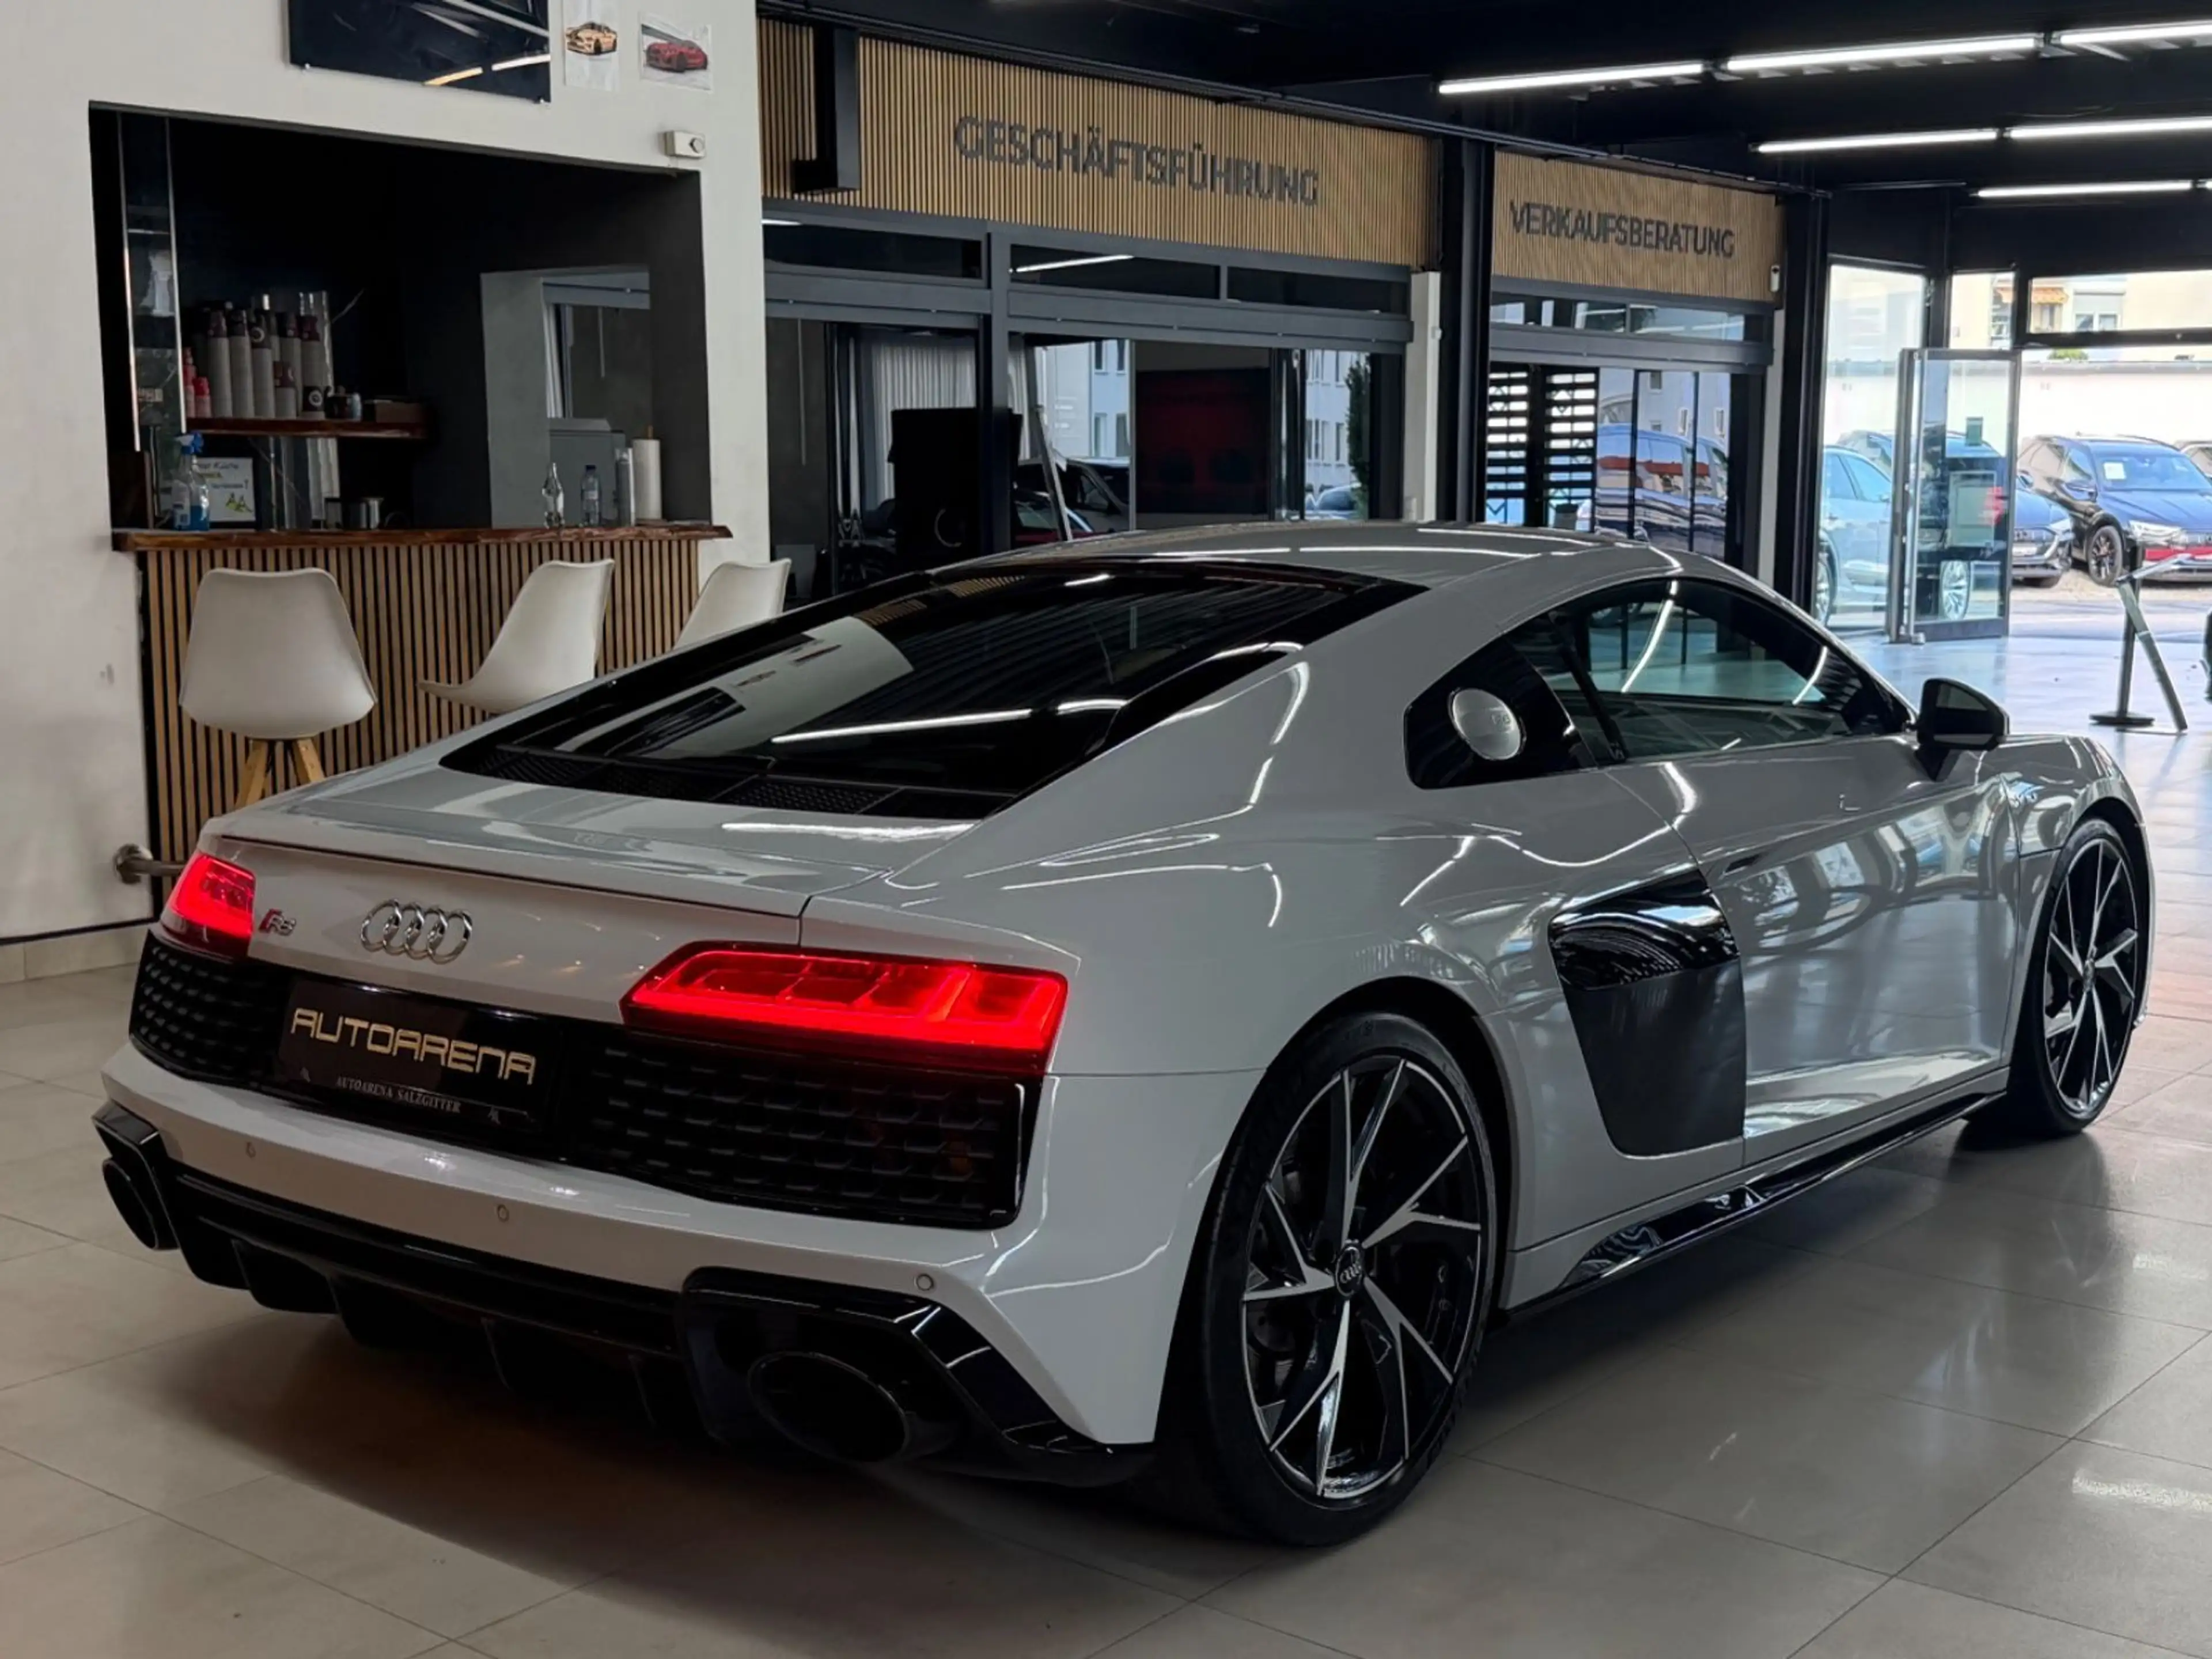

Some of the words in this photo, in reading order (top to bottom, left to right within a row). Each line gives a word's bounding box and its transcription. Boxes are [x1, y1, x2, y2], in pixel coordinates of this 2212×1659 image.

[955, 117, 1319, 205] GESCHÄFTSFÜHRUNG
[1510, 200, 1735, 257] VERKAUFSBERATUNG
[290, 1007, 536, 1085] AUTOARENA
[336, 1075, 393, 1098] AUTOARENA
